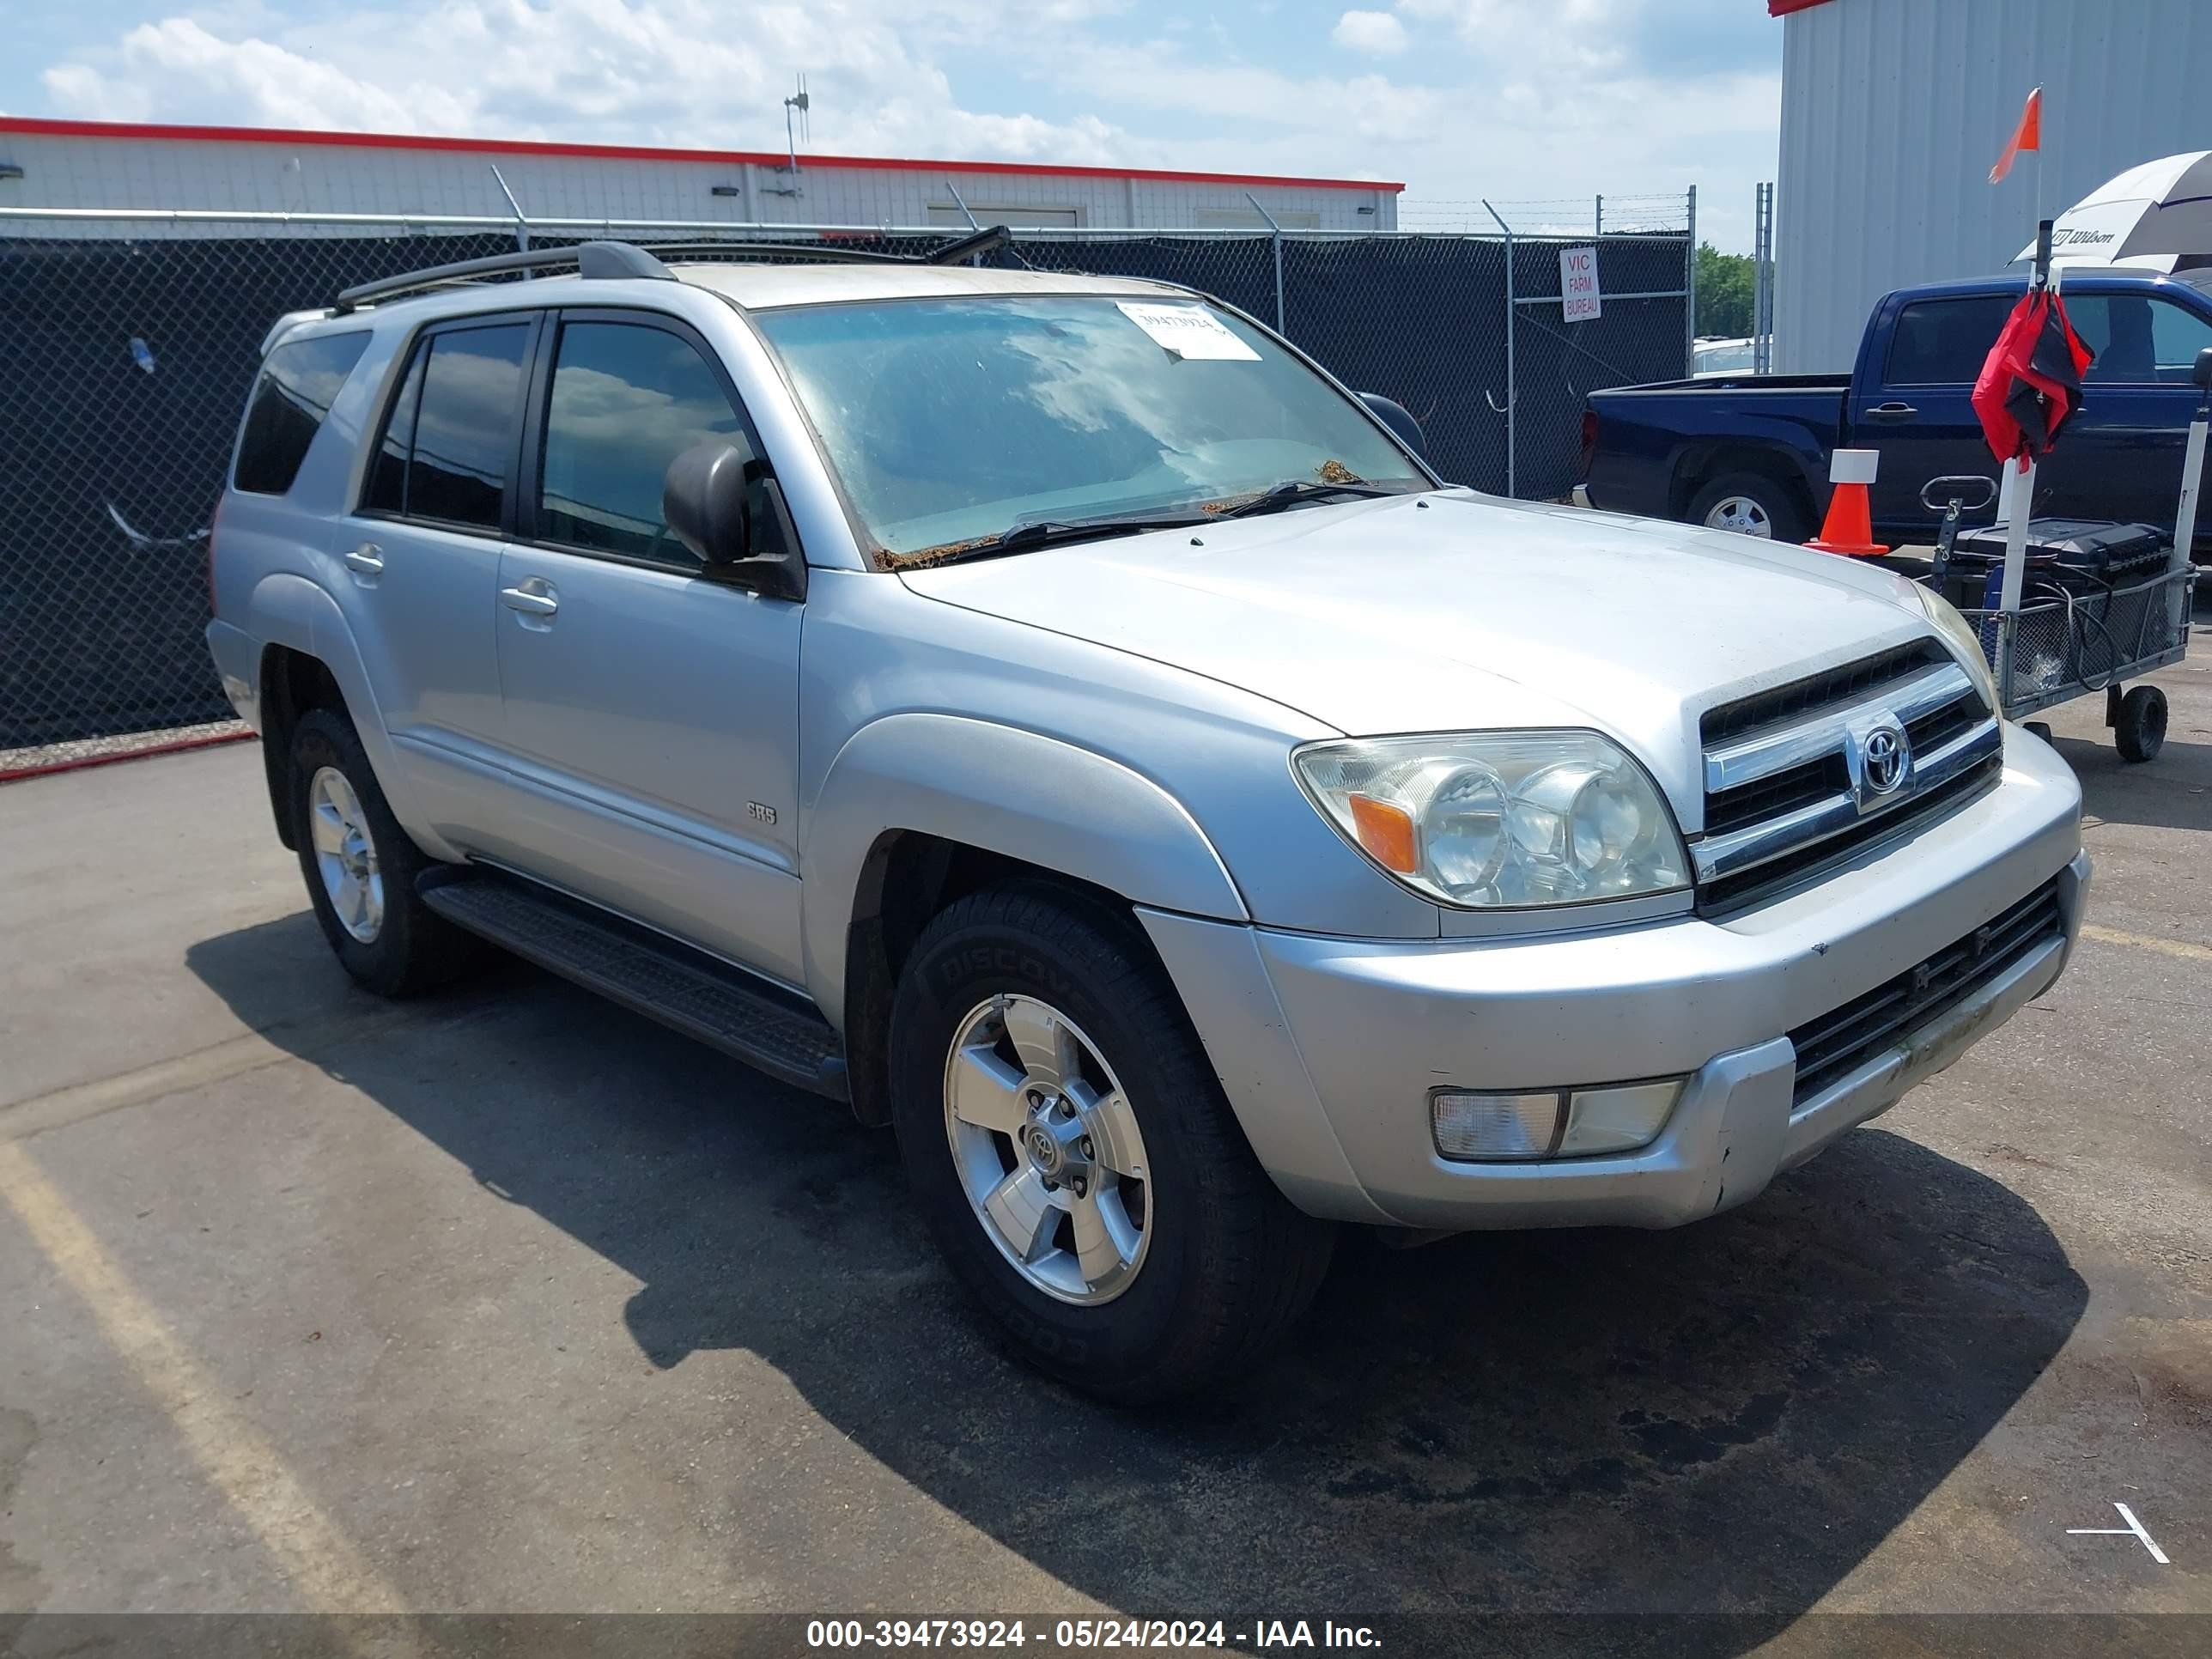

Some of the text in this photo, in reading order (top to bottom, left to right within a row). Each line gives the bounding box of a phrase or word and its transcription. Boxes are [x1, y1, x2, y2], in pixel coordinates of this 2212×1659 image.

[2069, 229, 2116, 244] Wilson
[1567, 254, 1590, 272] VIC
[1569, 276, 1593, 294] FARM
[1566, 297, 1597, 316] BUREAU
[1138, 314, 1215, 330] 39473924
[746, 800, 777, 825] SR5
